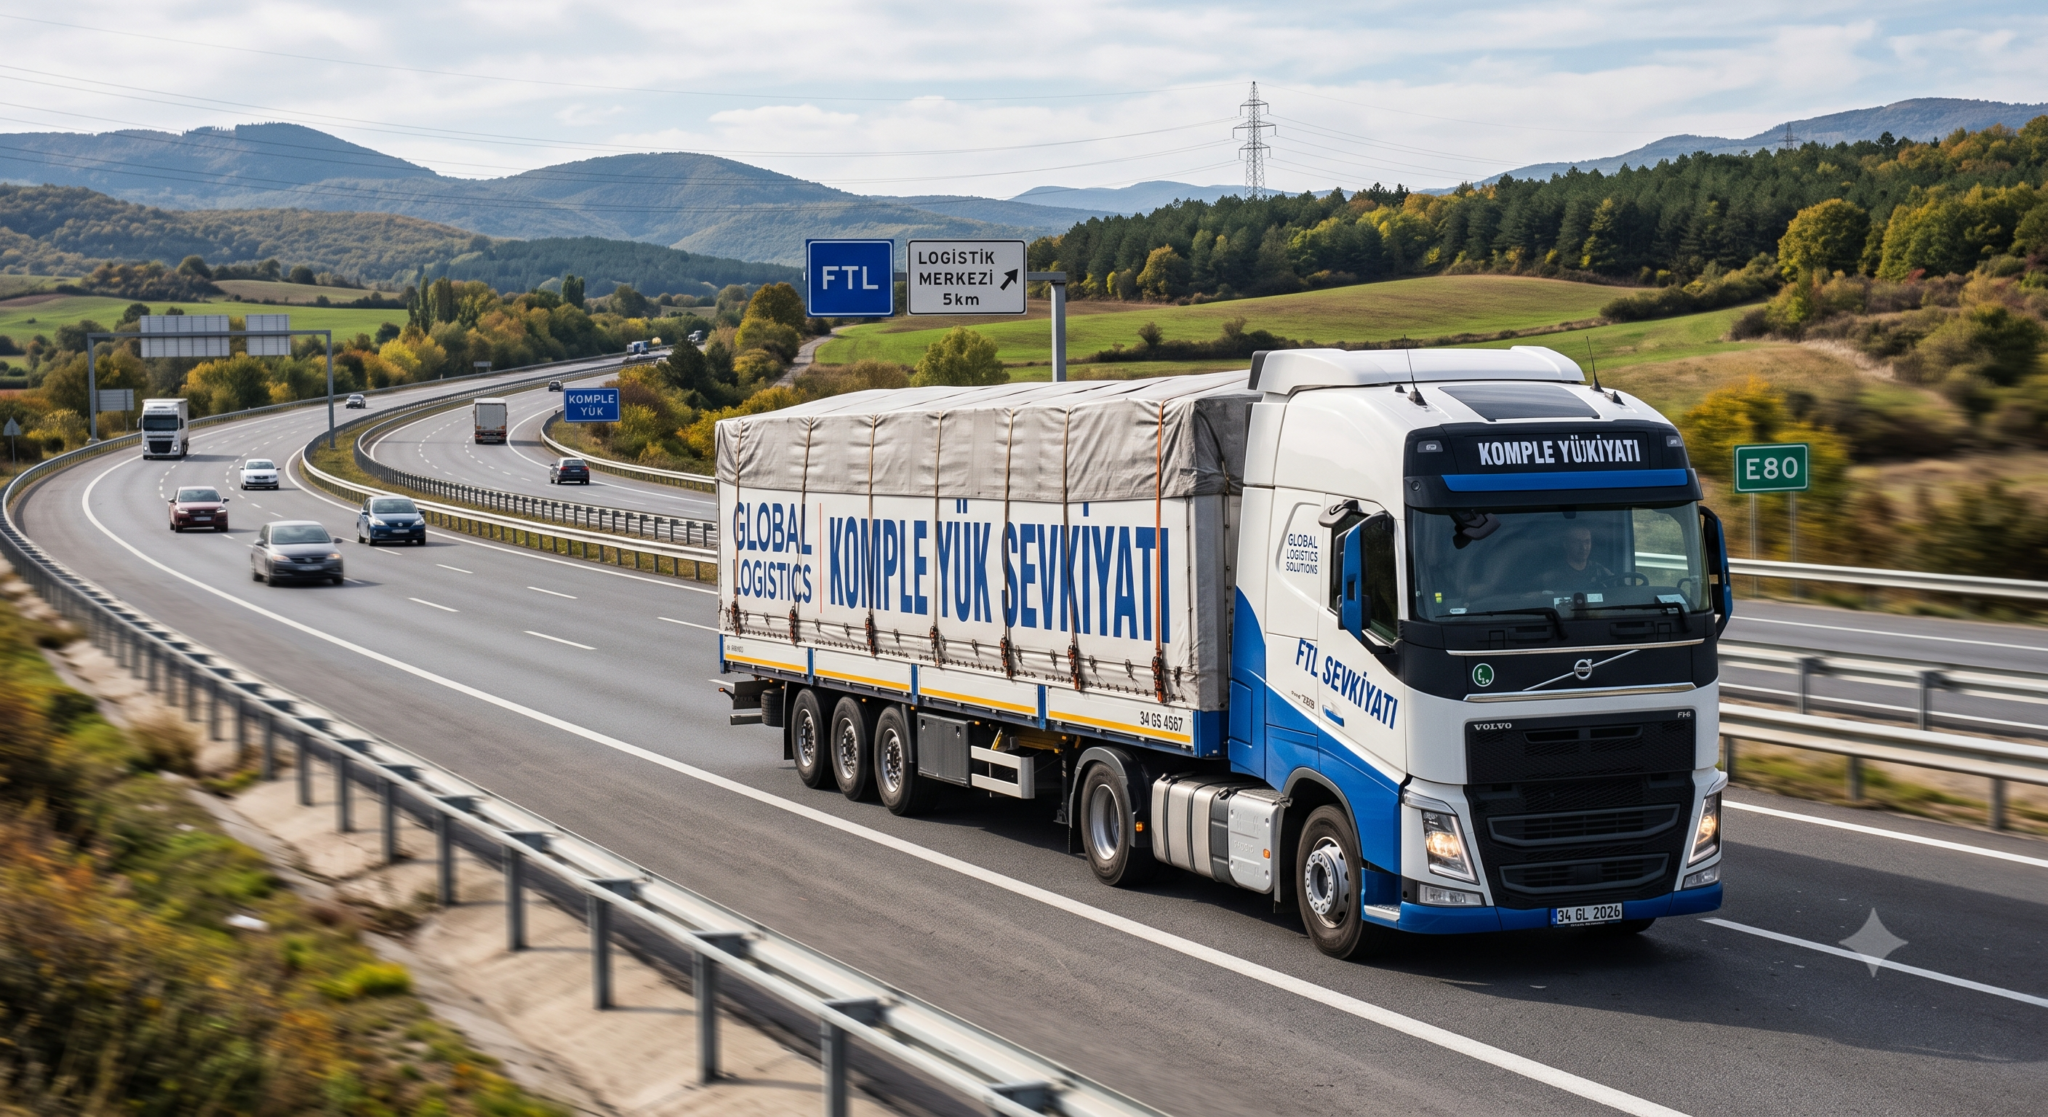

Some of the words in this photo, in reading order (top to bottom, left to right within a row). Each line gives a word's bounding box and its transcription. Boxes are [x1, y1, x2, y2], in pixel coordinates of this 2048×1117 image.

[918, 248, 995, 265] LOGİSTİK
[822, 265, 879, 290] FTL
[919, 269, 993, 286] MERKEZİ
[568, 394, 615, 404] KOMPLE
[1478, 441, 1555, 466] KOMPLE
[1746, 456, 1799, 480] E80
[732, 501, 812, 556] GLOBAL
[1288, 533, 1318, 549] GLOBAL
[1286, 549, 1318, 563] LOGISTICS
[829, 516, 928, 616] KOMPLE
[937, 498, 992, 624] YÜK
[1001, 501, 1170, 644] SEVKİYATI
[1286, 561, 1318, 575] SOLUTIONS
[732, 558, 812, 604] LOGISTICS
[1295, 637, 1318, 678] FTL
[1322, 655, 1398, 730] SEVKİYATI
[1140, 711, 1149, 726] 34
[1151, 713, 1161, 728] GS
[1163, 715, 1183, 732] 4567
[1473, 722, 1512, 731] VOLVO
[1558, 909, 1571, 922] 34
[1575, 908, 1589, 921] GL
[1593, 905, 1620, 919] 2026
